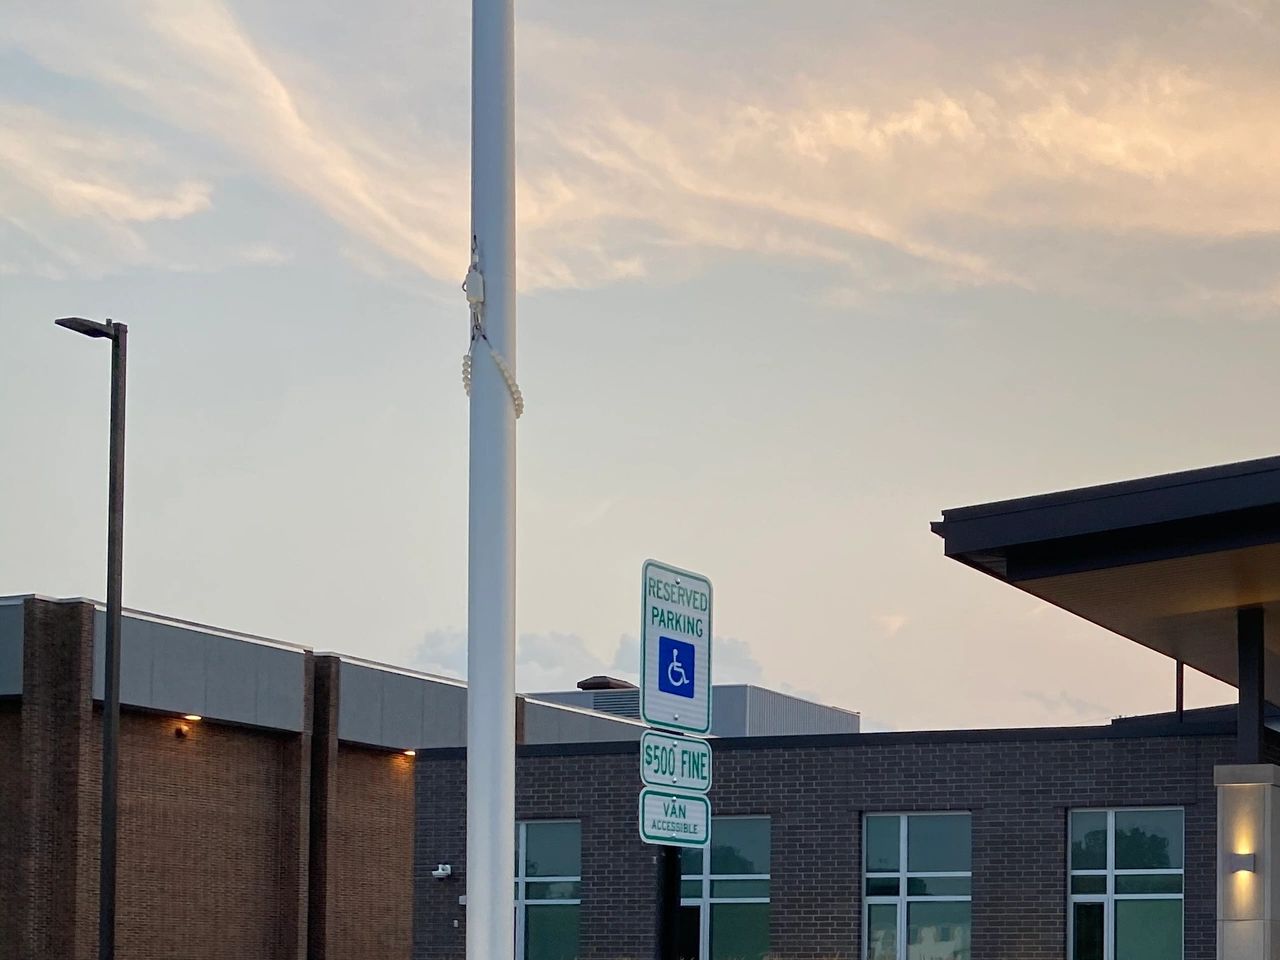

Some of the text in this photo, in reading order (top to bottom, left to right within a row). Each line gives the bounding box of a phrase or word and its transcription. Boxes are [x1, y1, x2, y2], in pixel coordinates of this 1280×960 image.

[648, 577, 708, 612] RESERVED
[651, 606, 703, 638] PARKING
[645, 744, 708, 781] $500 FINE
[663, 802, 687, 819] VAN
[651, 819, 700, 835] ACCESSIBLE
